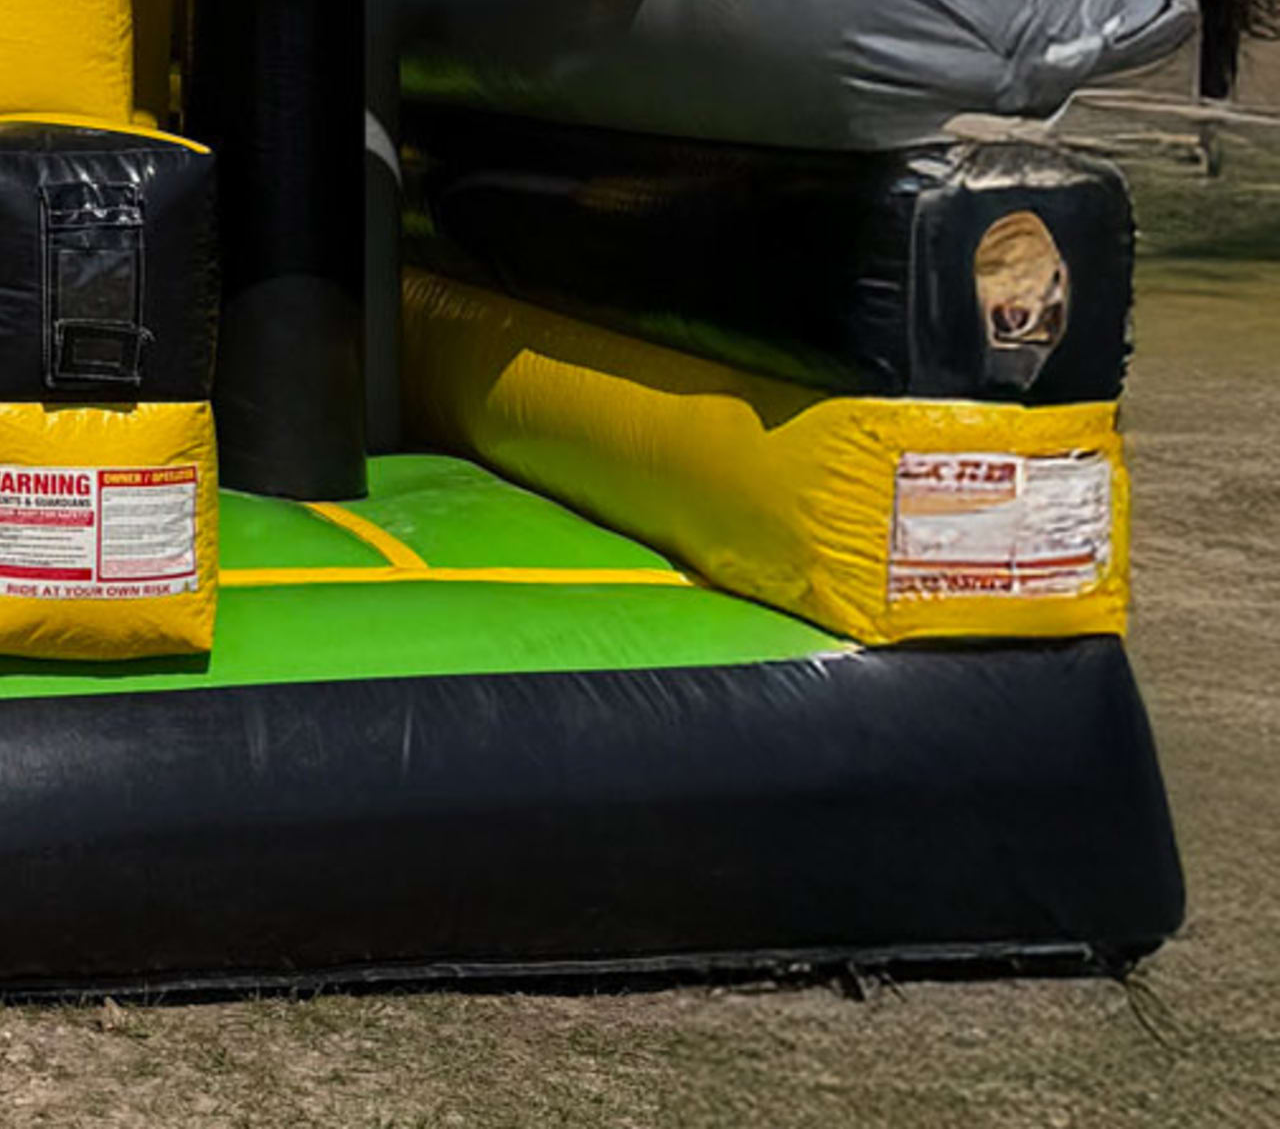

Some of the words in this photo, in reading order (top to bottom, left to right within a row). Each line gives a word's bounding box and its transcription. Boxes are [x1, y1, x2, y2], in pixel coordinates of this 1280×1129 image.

[35, 497, 92, 507] GUARDIANS
[6, 583, 38, 595] RIDE
[42, 585, 61, 596] AT
[65, 586, 103, 596] YOUR
[106, 585, 140, 596] OWN
[143, 583, 171, 594] RISK
